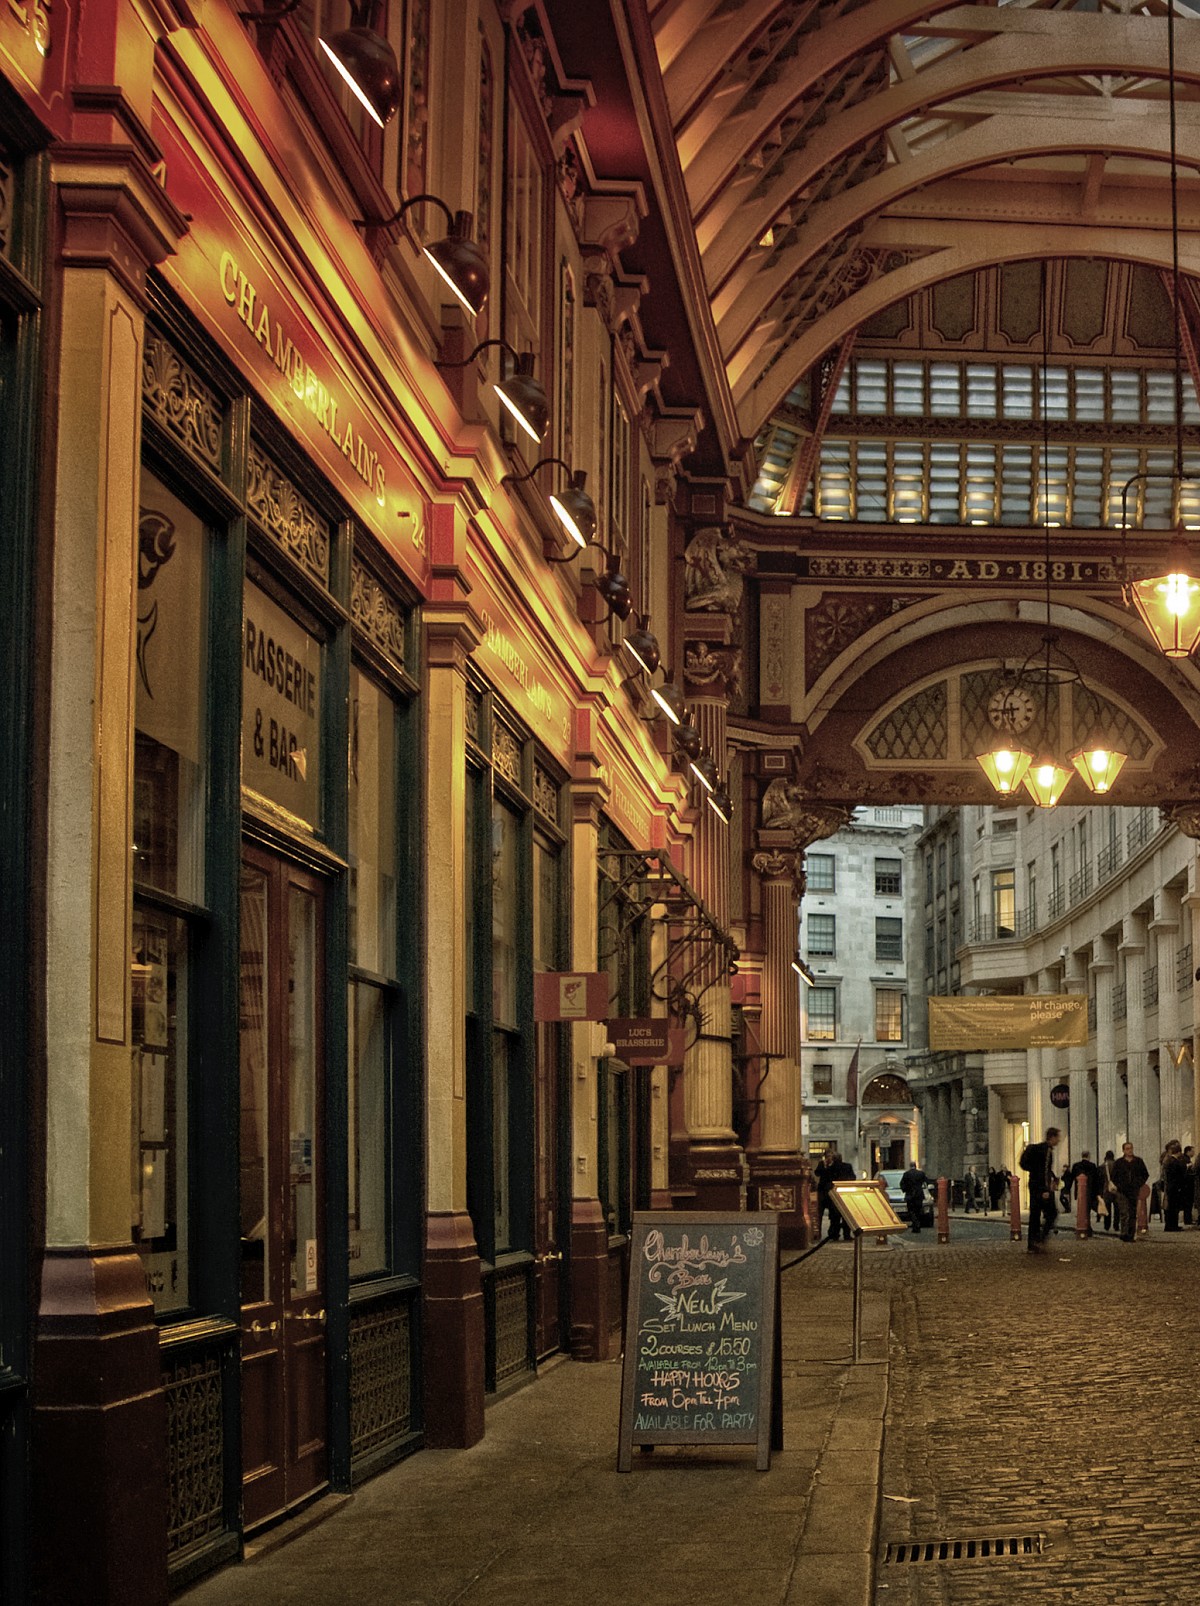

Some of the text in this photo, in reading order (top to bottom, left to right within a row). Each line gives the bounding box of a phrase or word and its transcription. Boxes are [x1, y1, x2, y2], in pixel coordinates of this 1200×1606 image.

[219, 251, 386, 507] CHAMBERLAIN'S
[1018, 561, 1083, 581] 1881
[246, 617, 316, 720] RASSERIE
[253, 707, 299, 783] & BAR
[1029, 1000, 1083, 1012] All change,
[1030, 1010, 1063, 1022] please
[616, 1038, 665, 1048] BRASSERIE
[628, 1028, 652, 1037] LUC'S
[676, 1287, 718, 1315] NEW
[679, 1311, 716, 1333] LUNCH
[719, 1311, 758, 1332] MENU
[650, 1370, 740, 1391] HAPPY HOURS
[640, 1392, 669, 1408] FROM
[671, 1388, 698, 1411] 5pm
[713, 1388, 740, 1411] 7pm
[634, 1411, 756, 1432] AVAILABLE FOR PARTY
